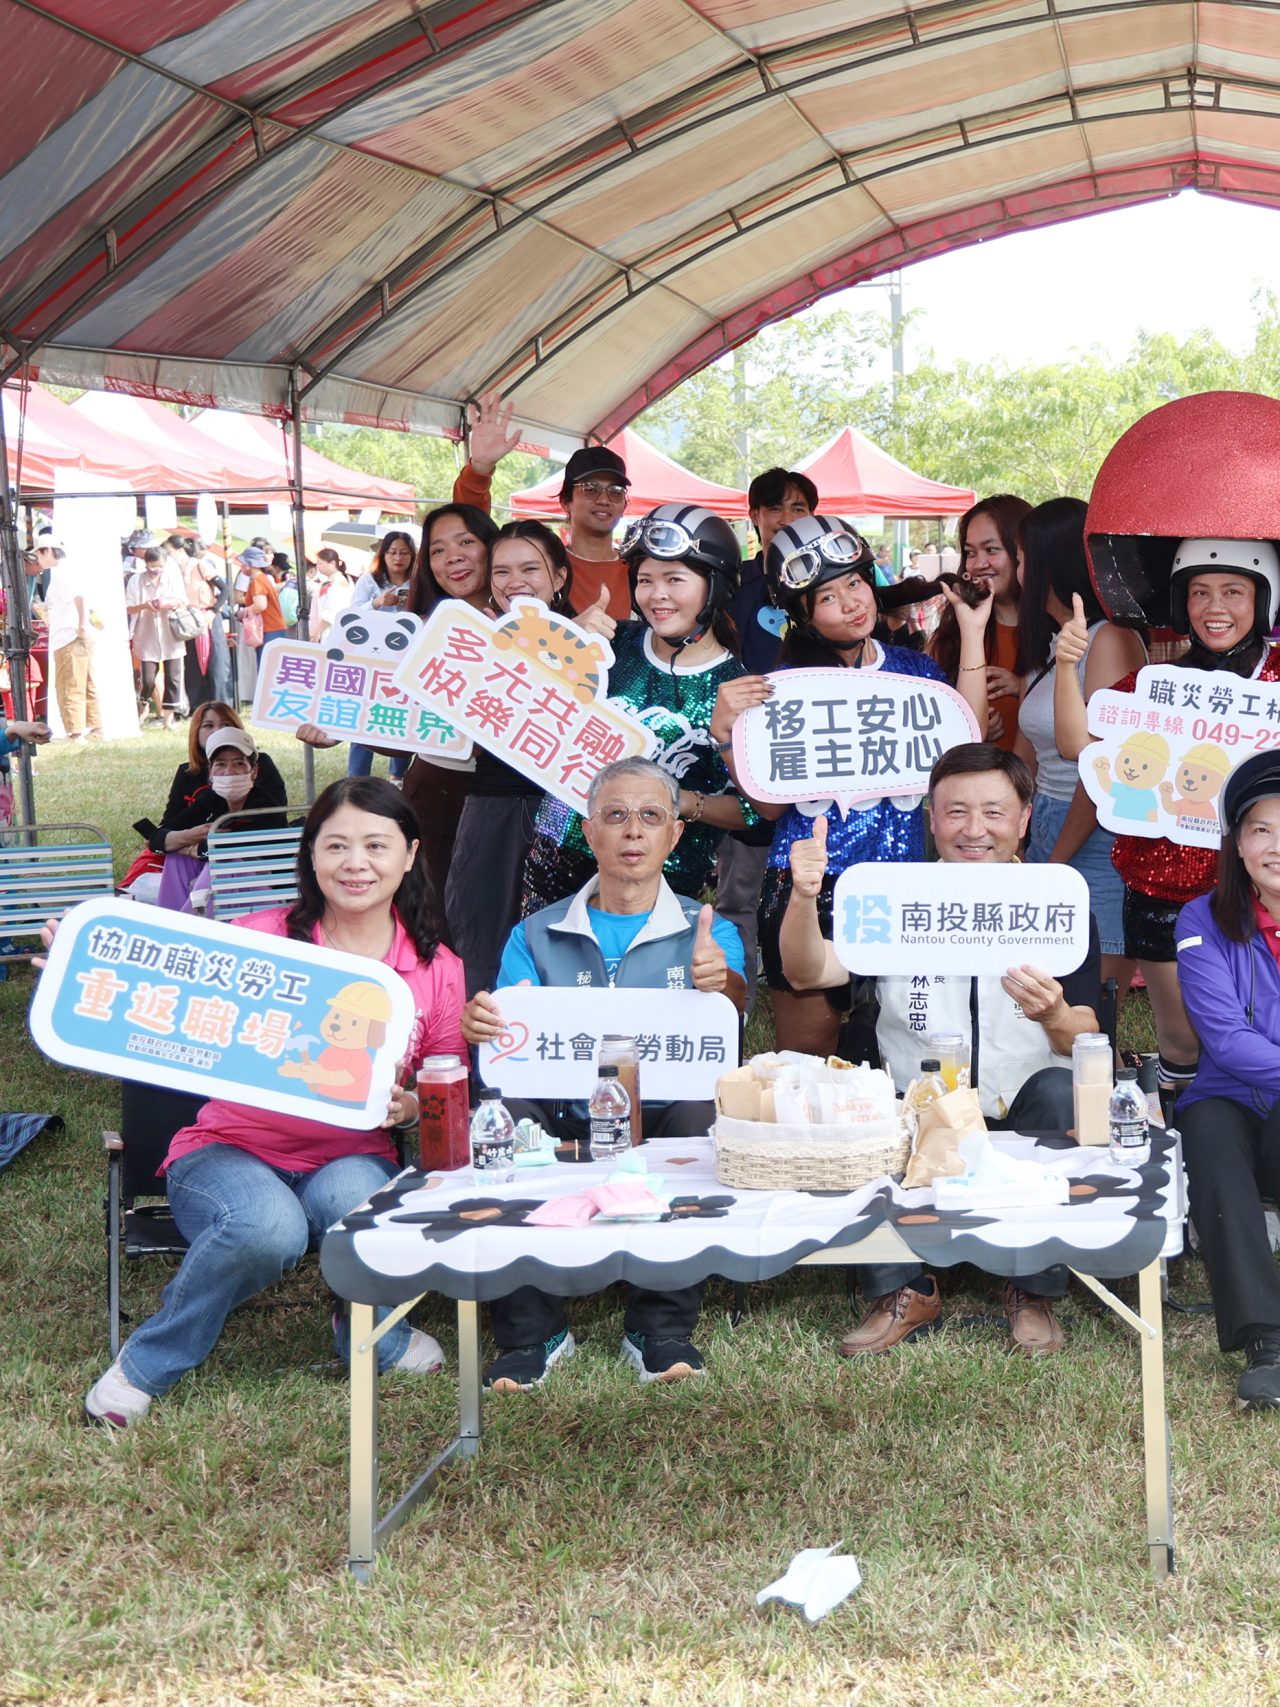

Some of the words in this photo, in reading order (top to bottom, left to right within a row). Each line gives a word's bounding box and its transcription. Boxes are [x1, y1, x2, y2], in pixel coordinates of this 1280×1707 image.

[268, 689, 456, 744] 友誼無界
[444, 627, 626, 766] 多元共融
[765, 693, 942, 739] 移工安心
[1098, 704, 1185, 736] 諮詢專線
[419, 657, 601, 801] 快樂同行
[769, 735, 944, 782] 雇主放心
[901, 901, 1076, 932] 南投縣政府
[90, 927, 309, 1002] 協助職災勞工
[901, 935, 945, 944] Nantou
[950, 935, 993, 947] County
[998, 935, 1074, 945] Government
[576, 970, 592, 987] 秘
[77, 971, 291, 1057] 重返職場
[909, 976, 930, 1032] 林志忠
[536, 1032, 726, 1063] 社會勞動局
